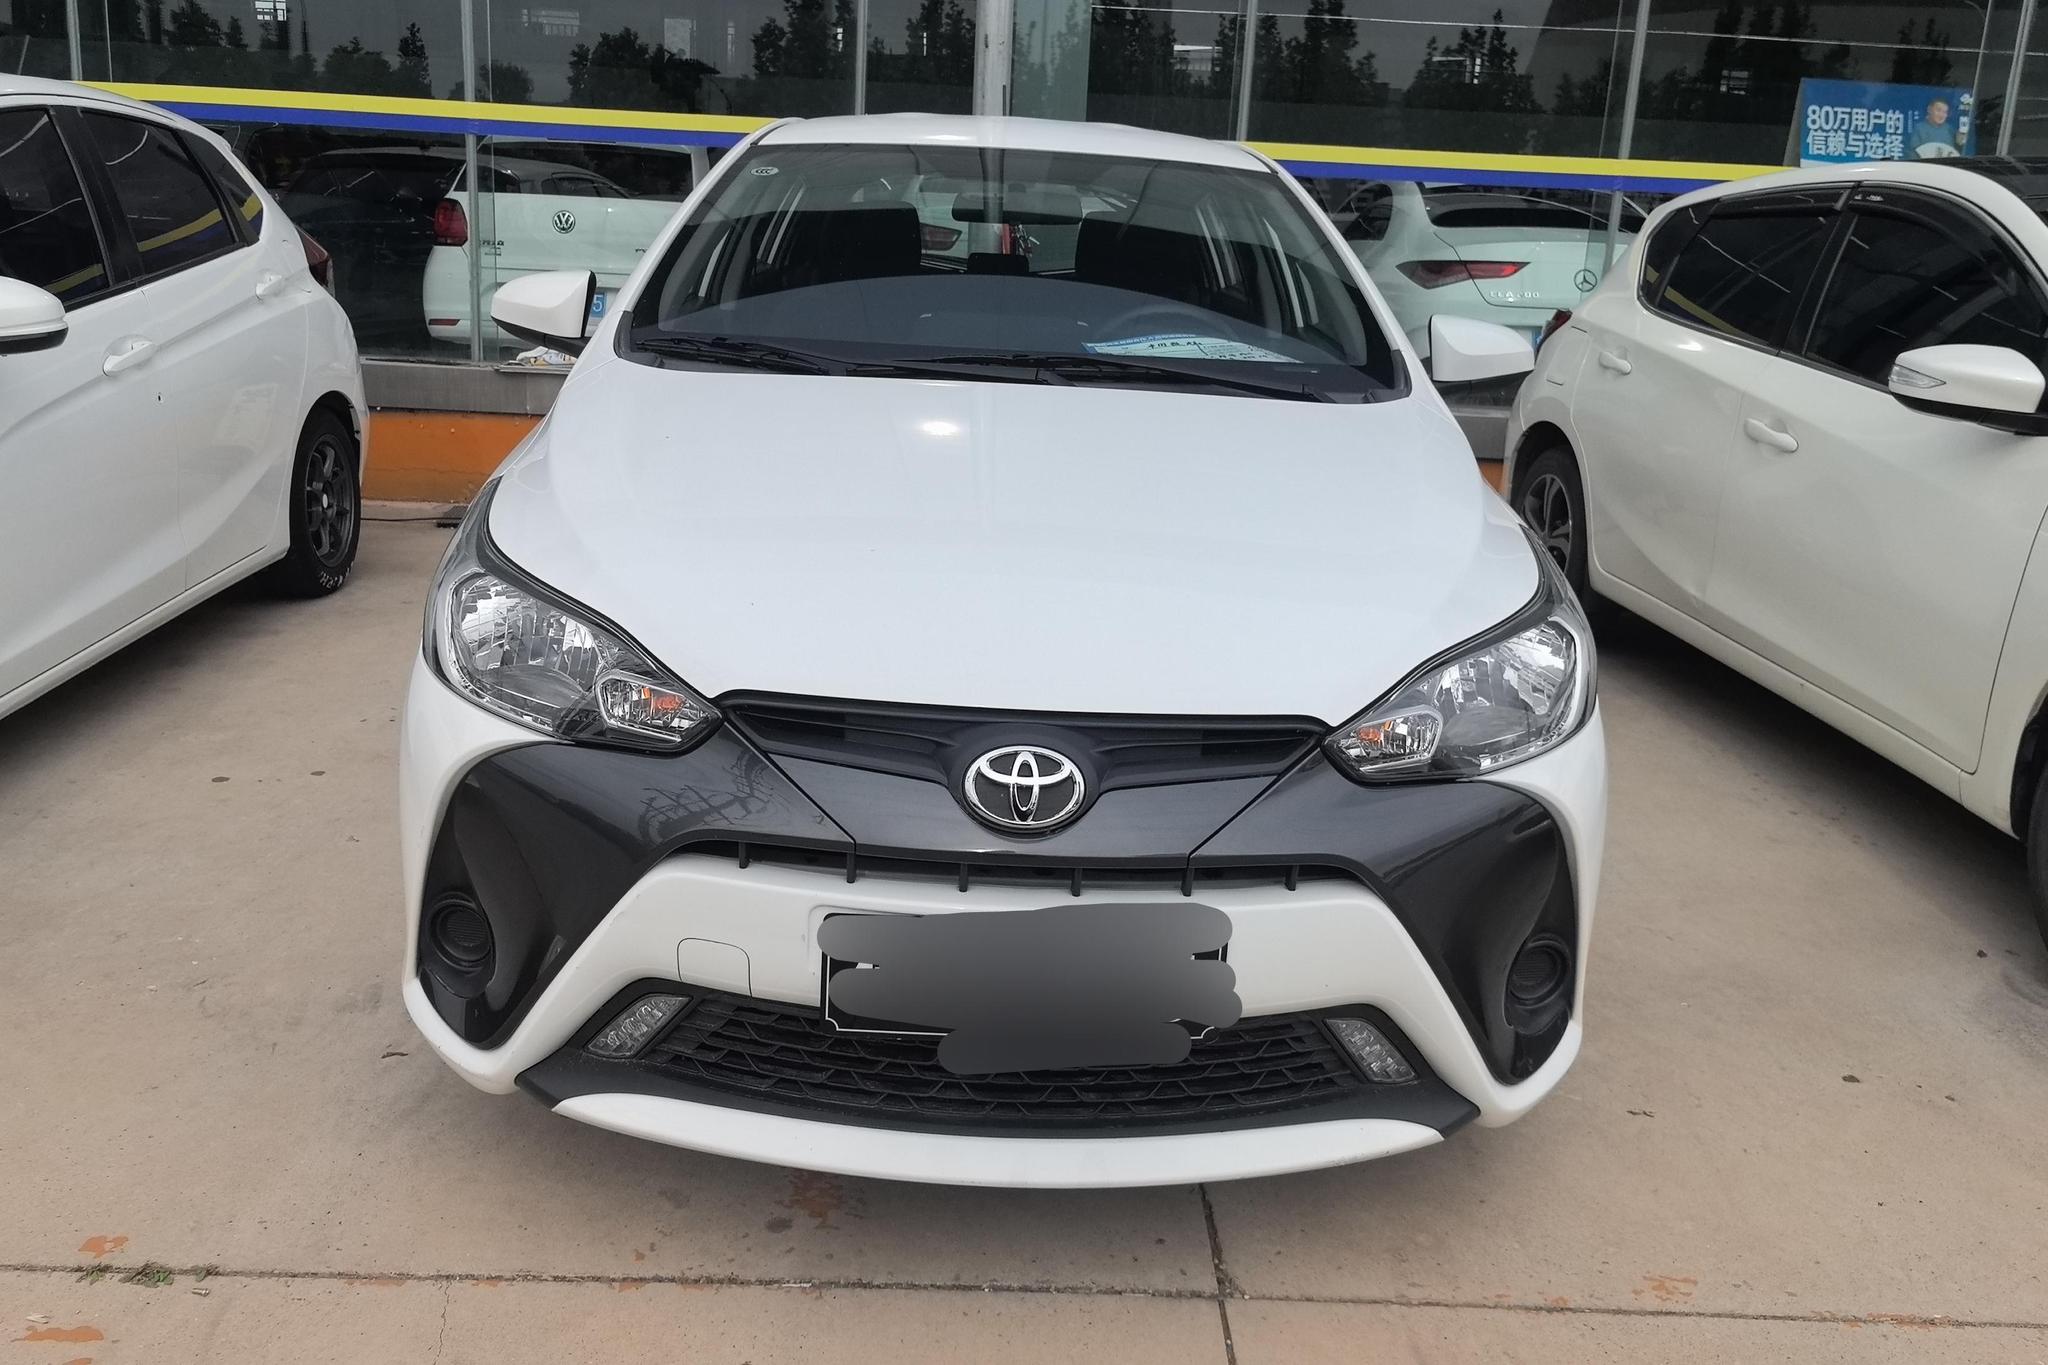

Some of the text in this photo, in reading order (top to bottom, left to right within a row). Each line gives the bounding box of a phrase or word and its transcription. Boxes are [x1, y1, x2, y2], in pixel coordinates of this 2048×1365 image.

[1807, 104, 1904, 134] 80万用户的
[1807, 129, 1904, 160] 信赖与选择
[552, 210, 576, 234] VW
